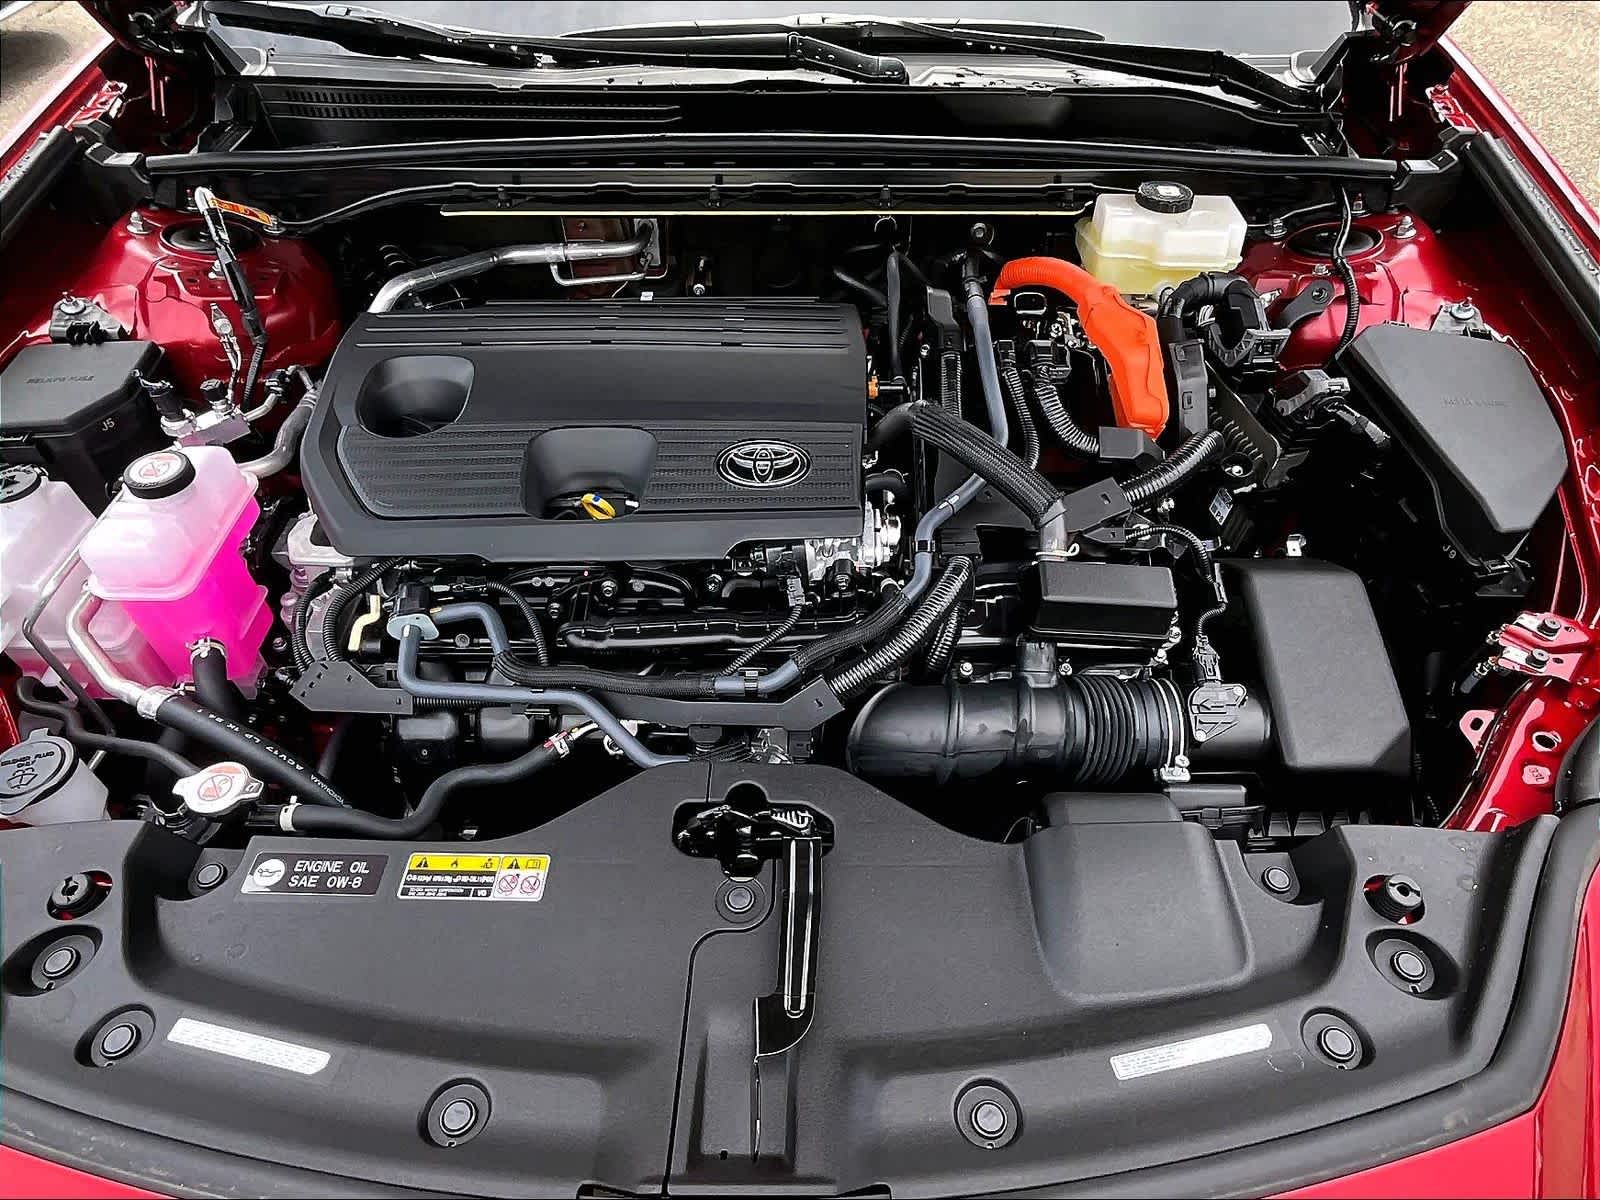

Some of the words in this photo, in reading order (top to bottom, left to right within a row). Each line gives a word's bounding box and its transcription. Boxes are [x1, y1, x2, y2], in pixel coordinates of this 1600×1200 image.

[294, 860, 344, 873] ENGINE
[350, 861, 370, 874] OIL
[288, 876, 319, 888] SAE
[326, 876, 363, 889] 0W-8
